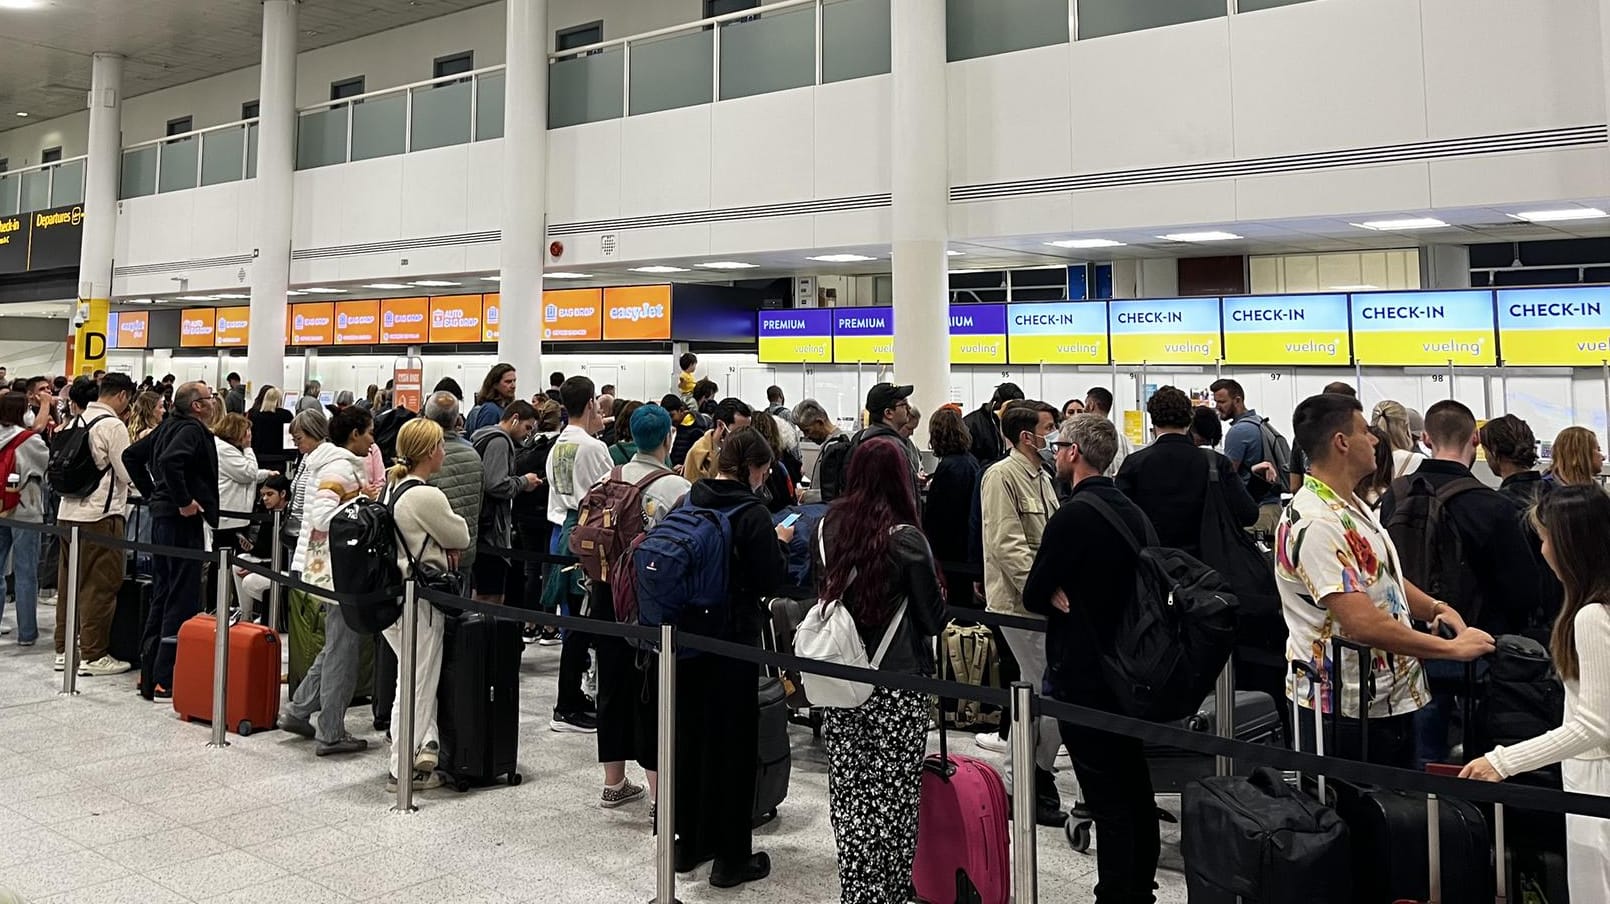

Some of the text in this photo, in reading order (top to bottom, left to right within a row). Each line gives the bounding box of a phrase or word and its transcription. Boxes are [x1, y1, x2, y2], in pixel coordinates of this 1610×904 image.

[36, 211, 71, 229] Departures
[609, 302, 664, 321] easyJet
[1232, 308, 1305, 321] CHECK-IN
[1362, 306, 1445, 319] CHECK-IN
[1509, 302, 1601, 317] CHECK-IN
[838, 317, 885, 329] PREMIUM
[1015, 314, 1073, 326] CHECK-IN
[1117, 311, 1182, 324] CHECK-IN
[763, 319, 805, 330] PREMIUM
[85, 332, 107, 361] D
[795, 344, 825, 356] vueling
[960, 342, 997, 356] vueling
[1057, 342, 1097, 356] vueling
[1164, 340, 1210, 355] vueling
[1285, 338, 1337, 355] vueling
[1422, 338, 1481, 355] vueling
[1270, 373, 1281, 381] 97
[1432, 374, 1444, 382] 98
